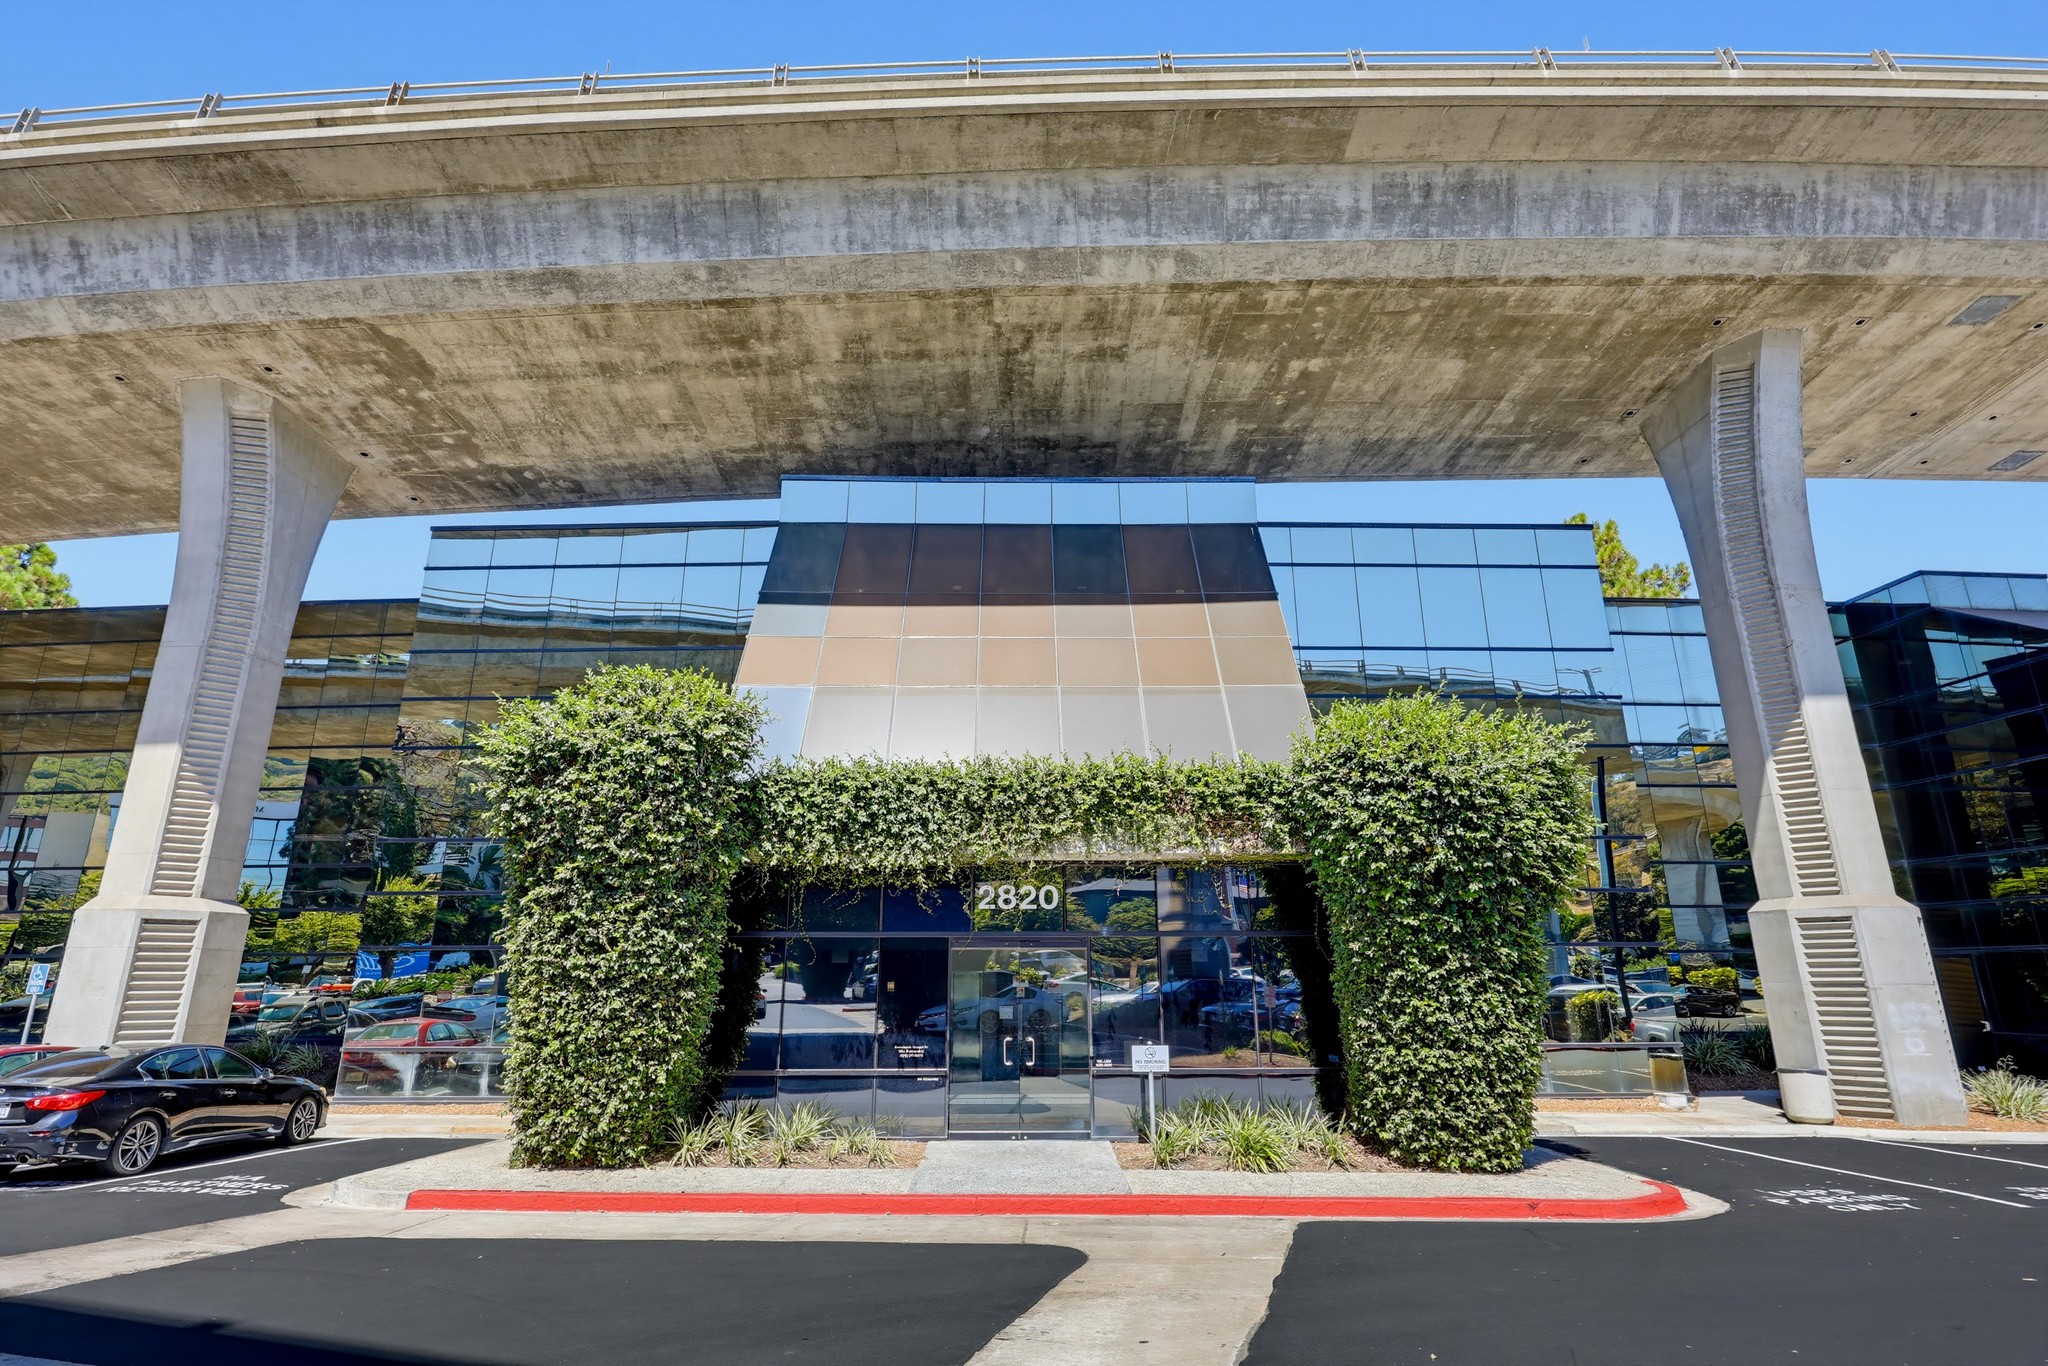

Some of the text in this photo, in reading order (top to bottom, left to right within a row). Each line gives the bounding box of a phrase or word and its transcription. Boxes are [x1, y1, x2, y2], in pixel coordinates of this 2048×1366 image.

[979, 885, 1058, 909] 2820
[1767, 1194, 1911, 1205] PARKING
[1827, 1203, 1922, 1212] ONLY
